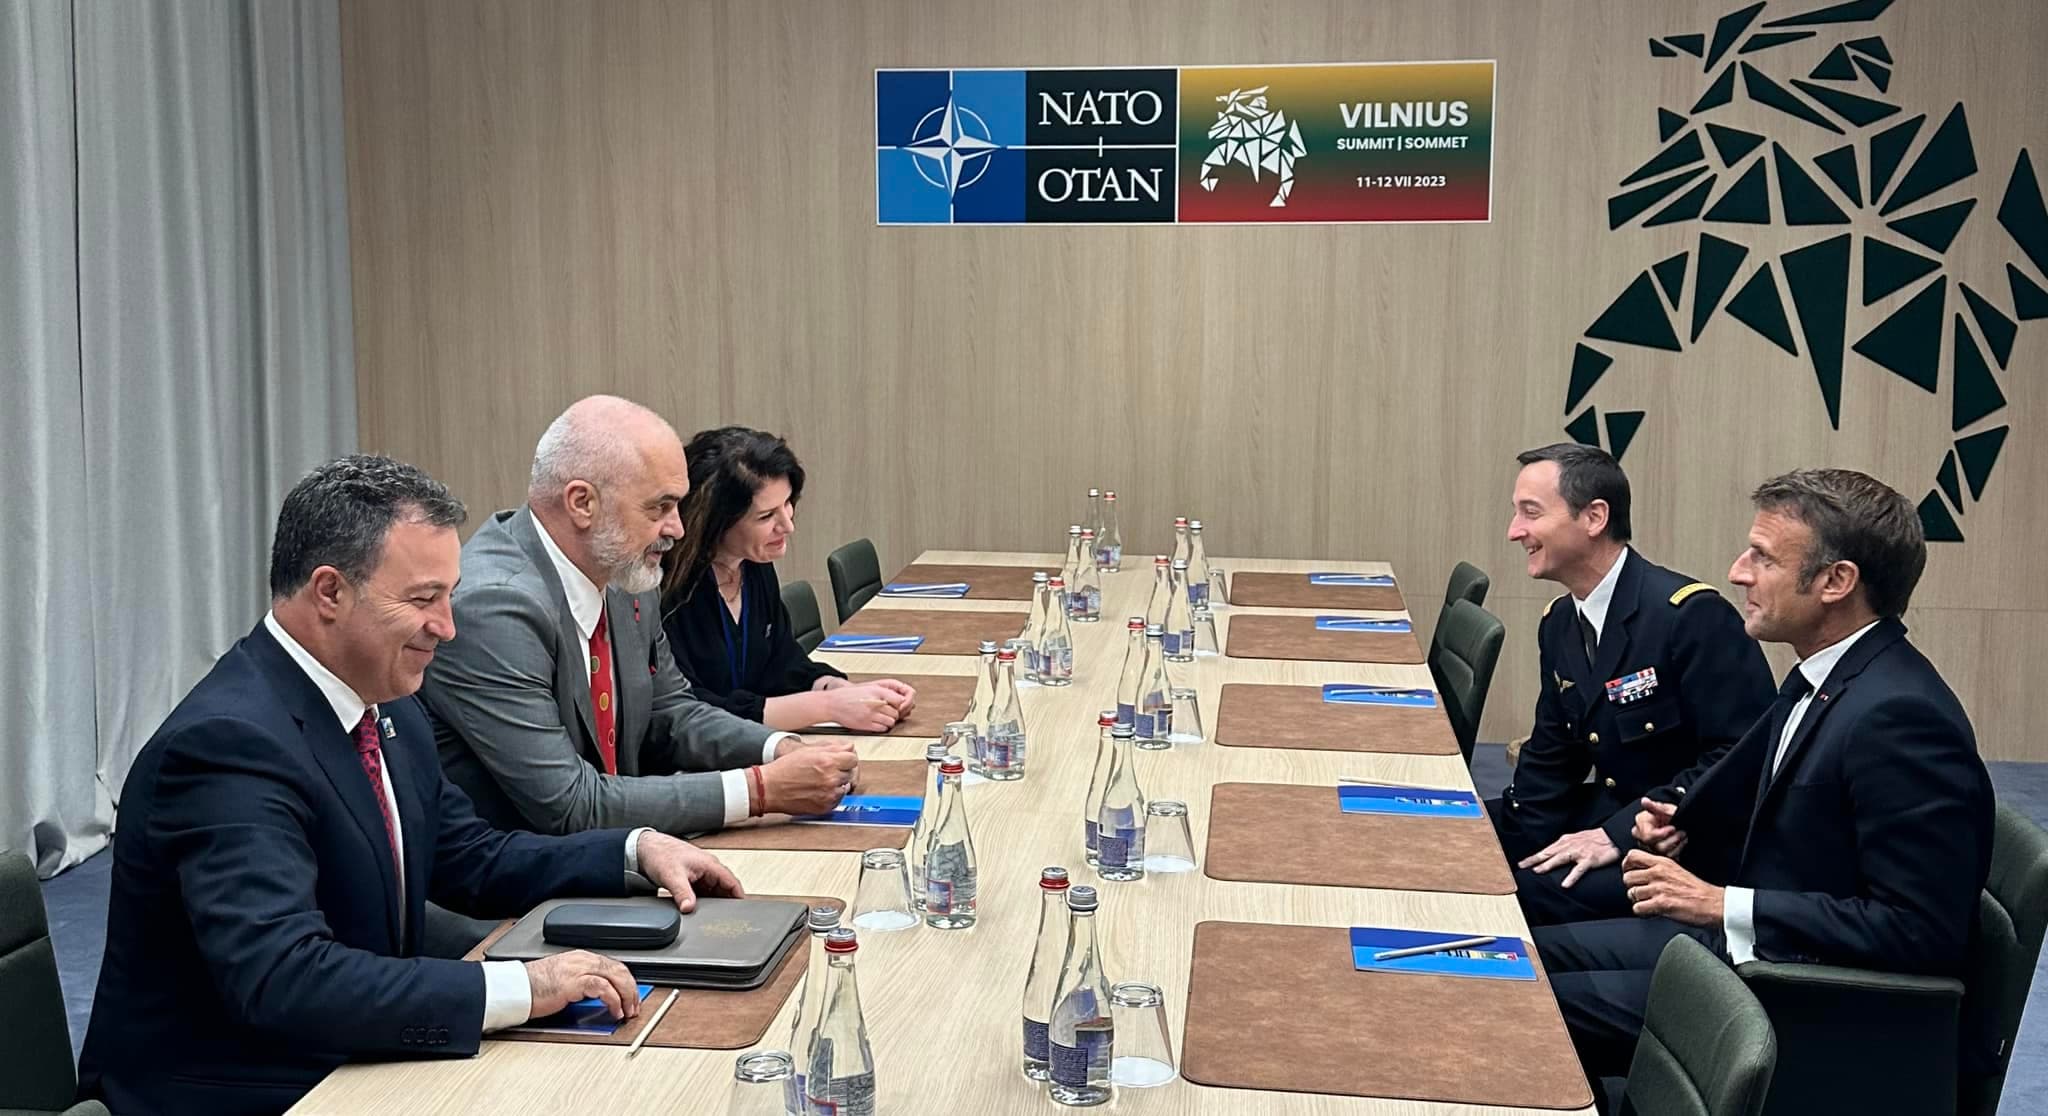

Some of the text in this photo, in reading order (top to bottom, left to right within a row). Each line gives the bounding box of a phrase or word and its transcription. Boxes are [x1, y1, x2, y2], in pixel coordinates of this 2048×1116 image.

[1038, 90, 1163, 126] NATO
[1339, 101, 1469, 128] VILNIUS
[1336, 137, 1395, 150] SUMMIT
[1404, 136, 1469, 149] SOMMET
[1038, 167, 1164, 202] OTAN
[1356, 175, 1446, 188] 11-12 VII 2023
